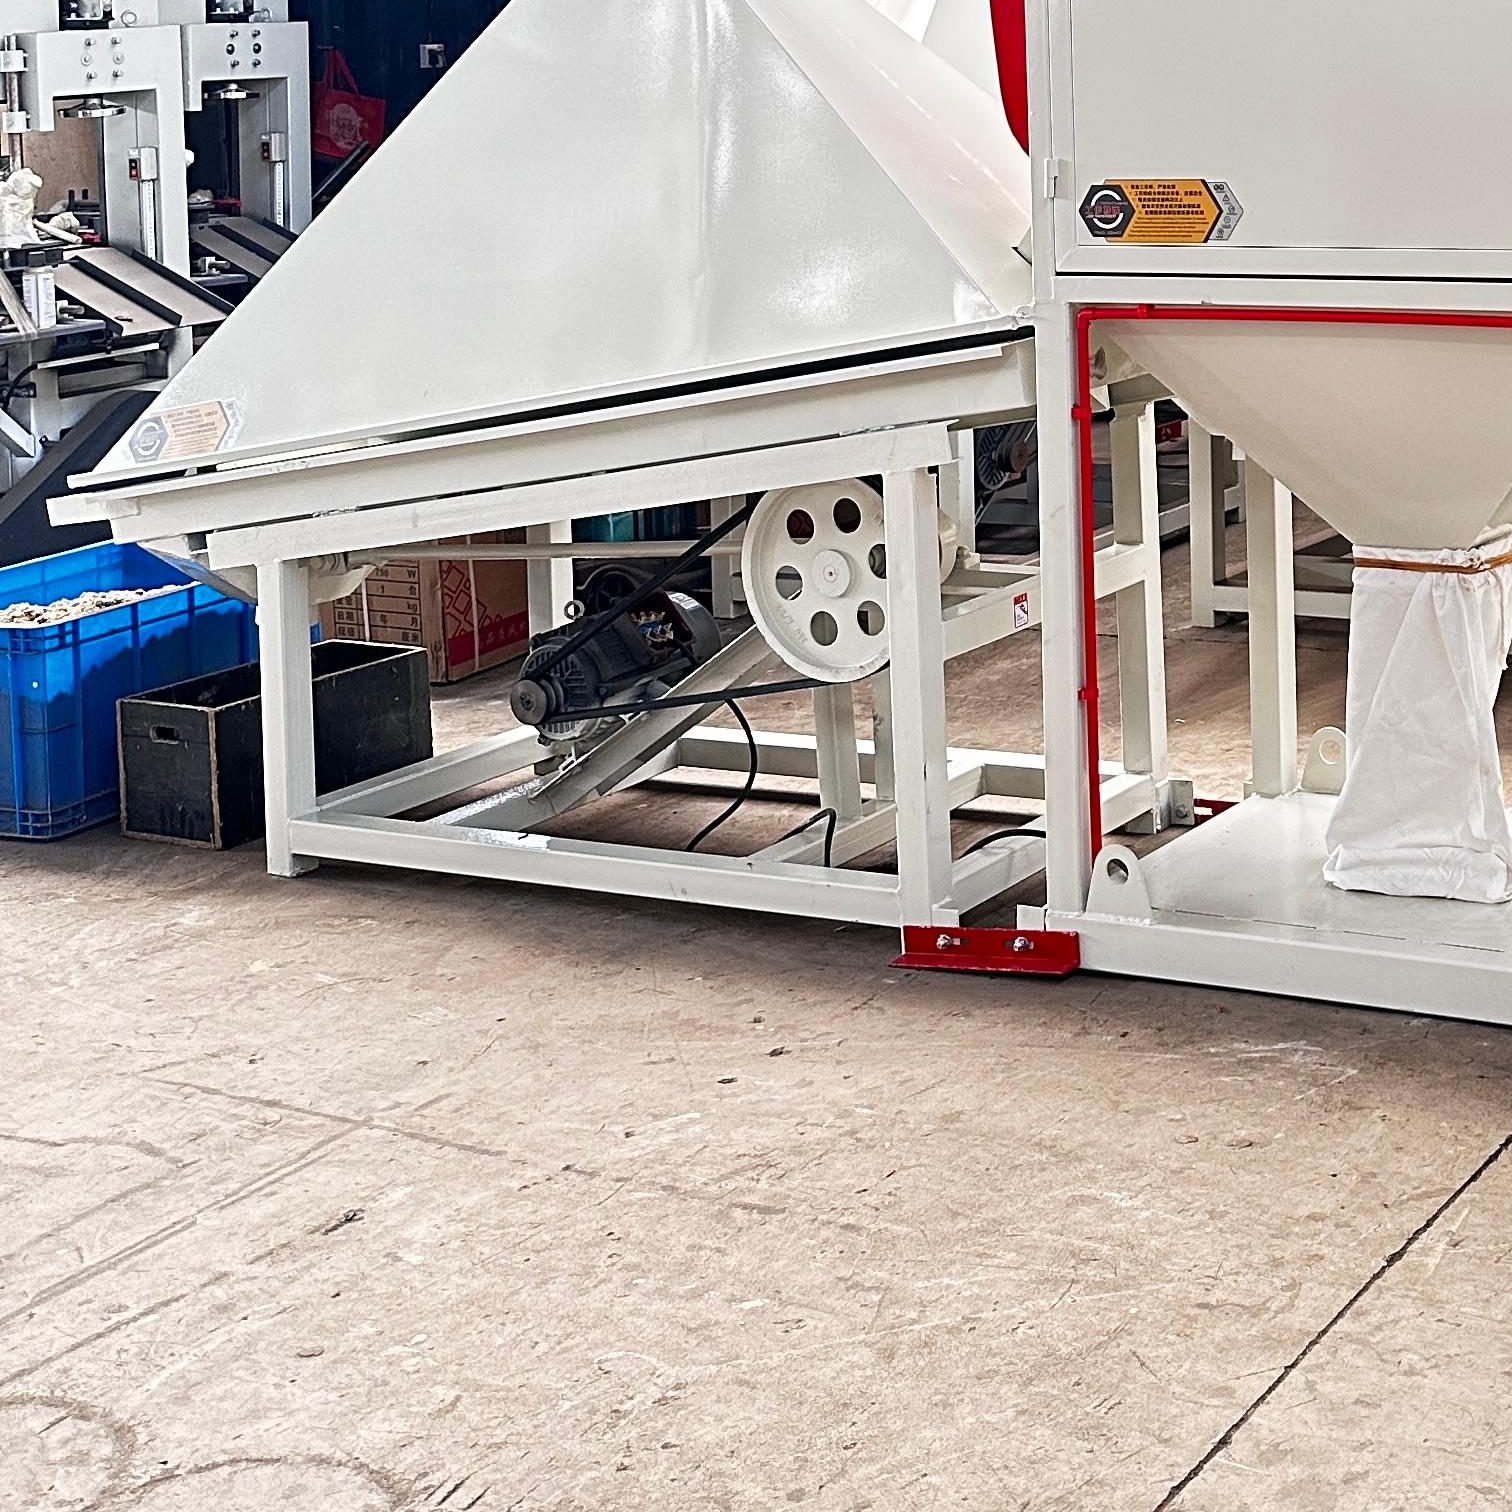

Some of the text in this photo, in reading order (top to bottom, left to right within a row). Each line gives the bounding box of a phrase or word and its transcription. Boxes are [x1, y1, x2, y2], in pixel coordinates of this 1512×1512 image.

[407, 569, 416, 578] W
[407, 601, 418, 614] kg
[410, 617, 419, 627] 月
